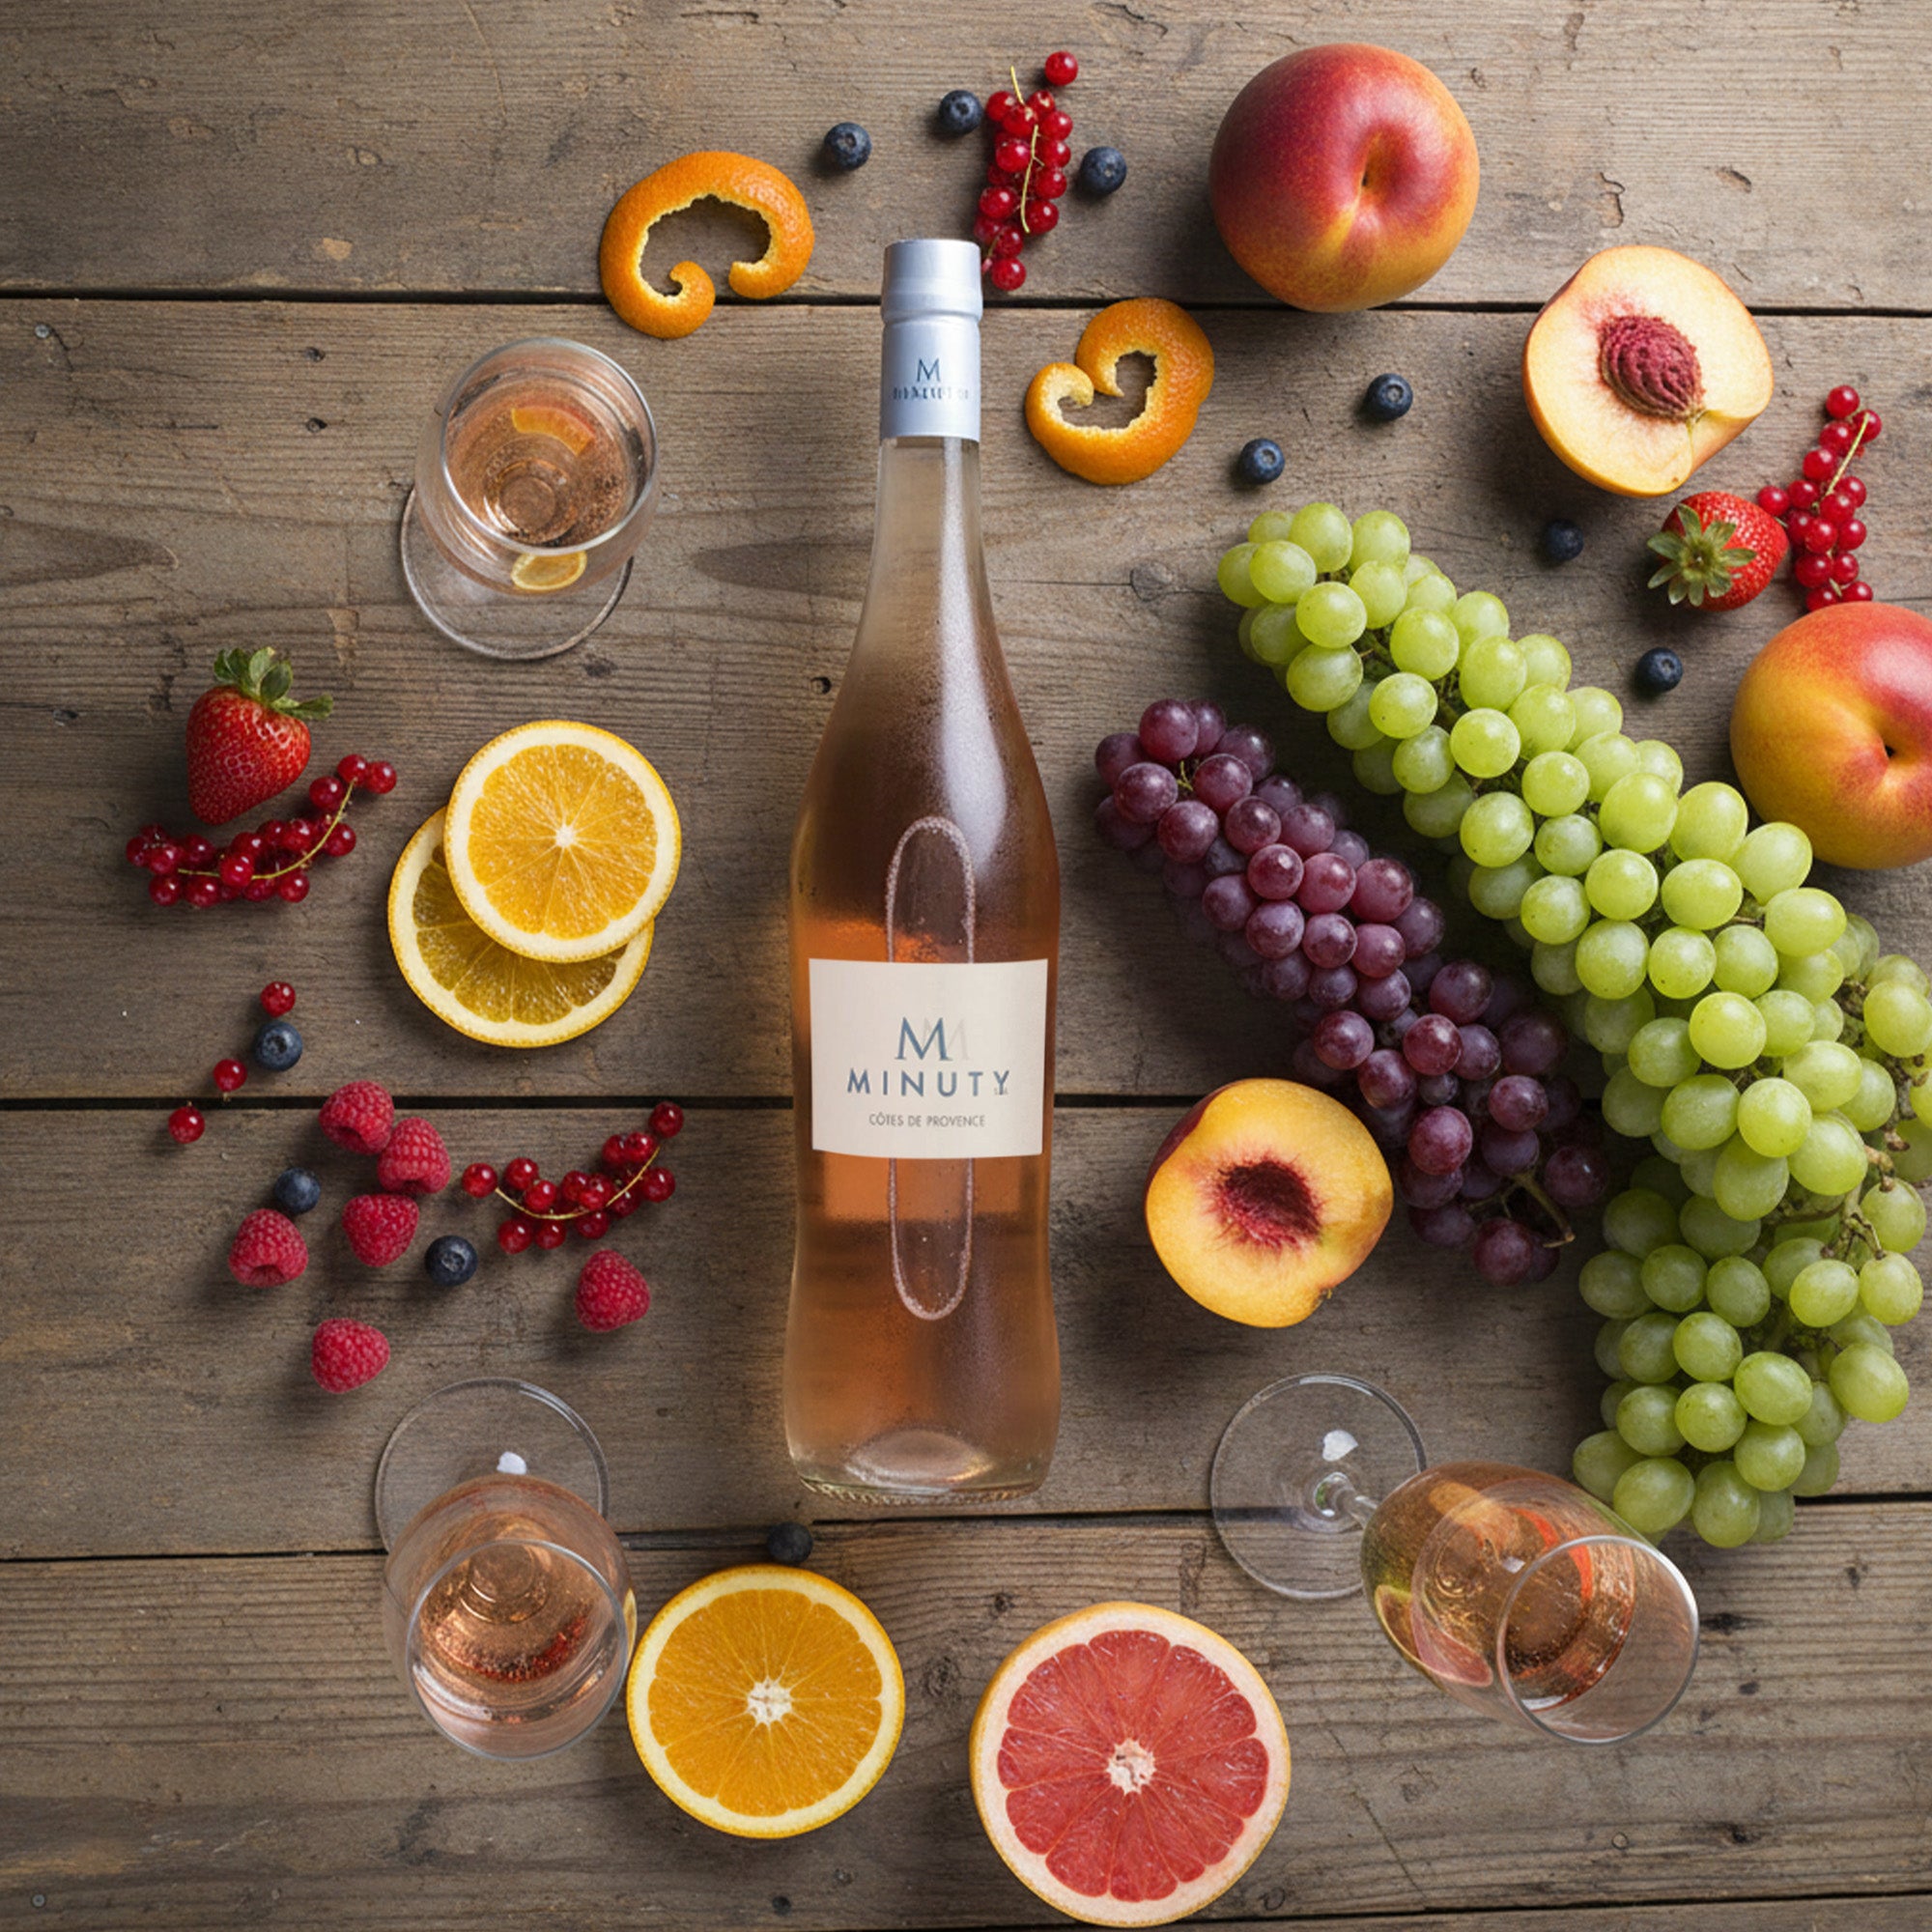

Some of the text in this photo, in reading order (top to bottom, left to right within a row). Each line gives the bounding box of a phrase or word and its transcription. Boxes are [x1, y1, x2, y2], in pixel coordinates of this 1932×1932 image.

[916, 357, 941, 383] M
[894, 1017, 953, 1061] M
[846, 1067, 1010, 1097] MINUTY
[868, 1112, 985, 1128] CÔTES DE PROVENCE
